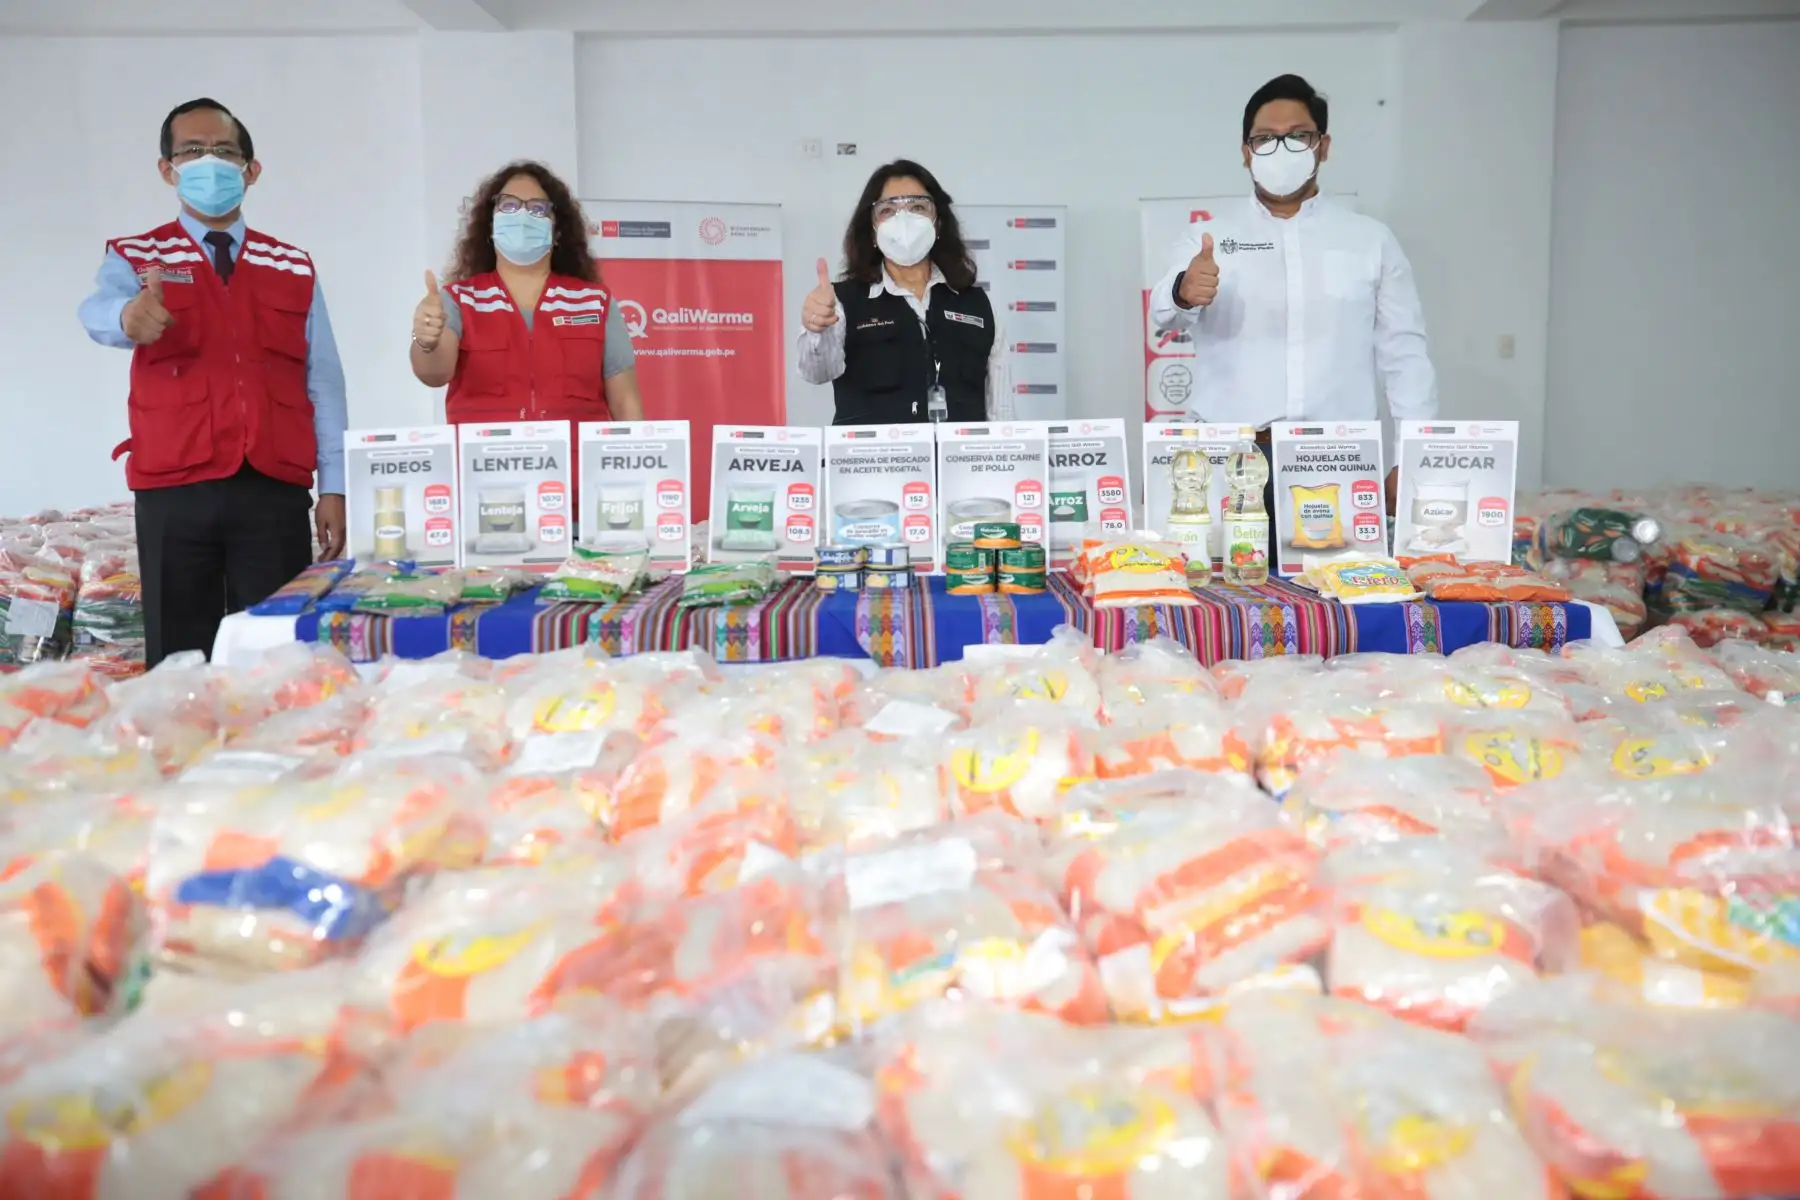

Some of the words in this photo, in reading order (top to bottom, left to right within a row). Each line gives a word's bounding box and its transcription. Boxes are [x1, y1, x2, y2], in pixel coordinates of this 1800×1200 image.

[652, 307, 754, 324] QaliWarma
[601, 455, 668, 470] FRIJOL
[830, 457, 876, 465] CONSERVA
[877, 456, 888, 464] DE
[890, 456, 931, 464] PESCADO
[945, 454, 994, 463] CONSERVA
[996, 454, 1008, 462] DE
[1009, 453, 1041, 462] CARNE
[1296, 454, 1346, 463] HOJUELAS
[1347, 454, 1361, 462] DE
[1419, 453, 1495, 470] AZÚCAR
[370, 460, 432, 475] FIDEOS
[472, 456, 558, 472] LENTEJA
[728, 458, 805, 473] ARVEJA
[852, 466, 881, 474] ACEITE
[884, 465, 922, 473] VEGETAL
[971, 464, 984, 472] DE
[985, 464, 1015, 472] POLLO
[1281, 464, 1314, 472] AVENA
[1316, 464, 1337, 472] CON
[1339, 464, 1377, 472] QUINUA
[480, 505, 524, 516] Lenteja
[601, 502, 639, 515] Frijol
[731, 503, 770, 514] Arveja
[1423, 507, 1454, 516] Azúcar
[1359, 527, 1376, 535] 33.3
